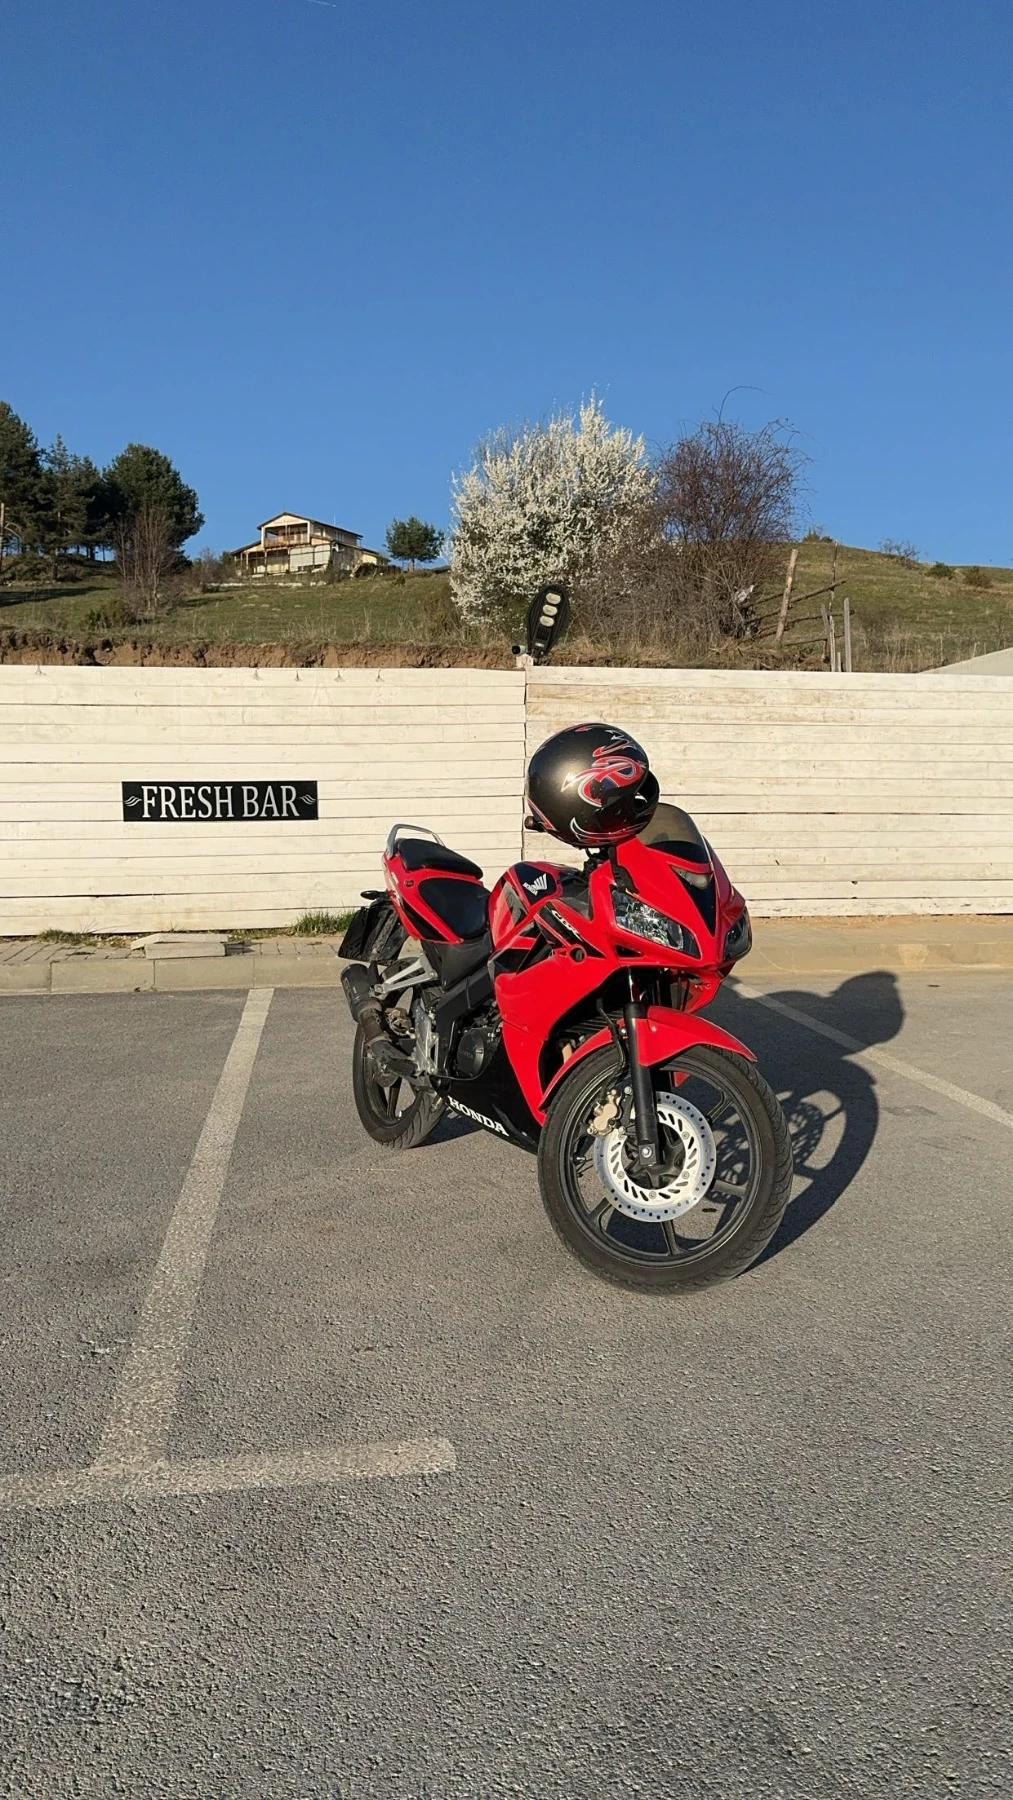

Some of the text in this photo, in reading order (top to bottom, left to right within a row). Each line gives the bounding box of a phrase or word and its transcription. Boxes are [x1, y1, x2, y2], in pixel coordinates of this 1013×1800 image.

[141, 785, 300, 818] FRESH BAR
[447, 1095, 510, 1137] HONDA
